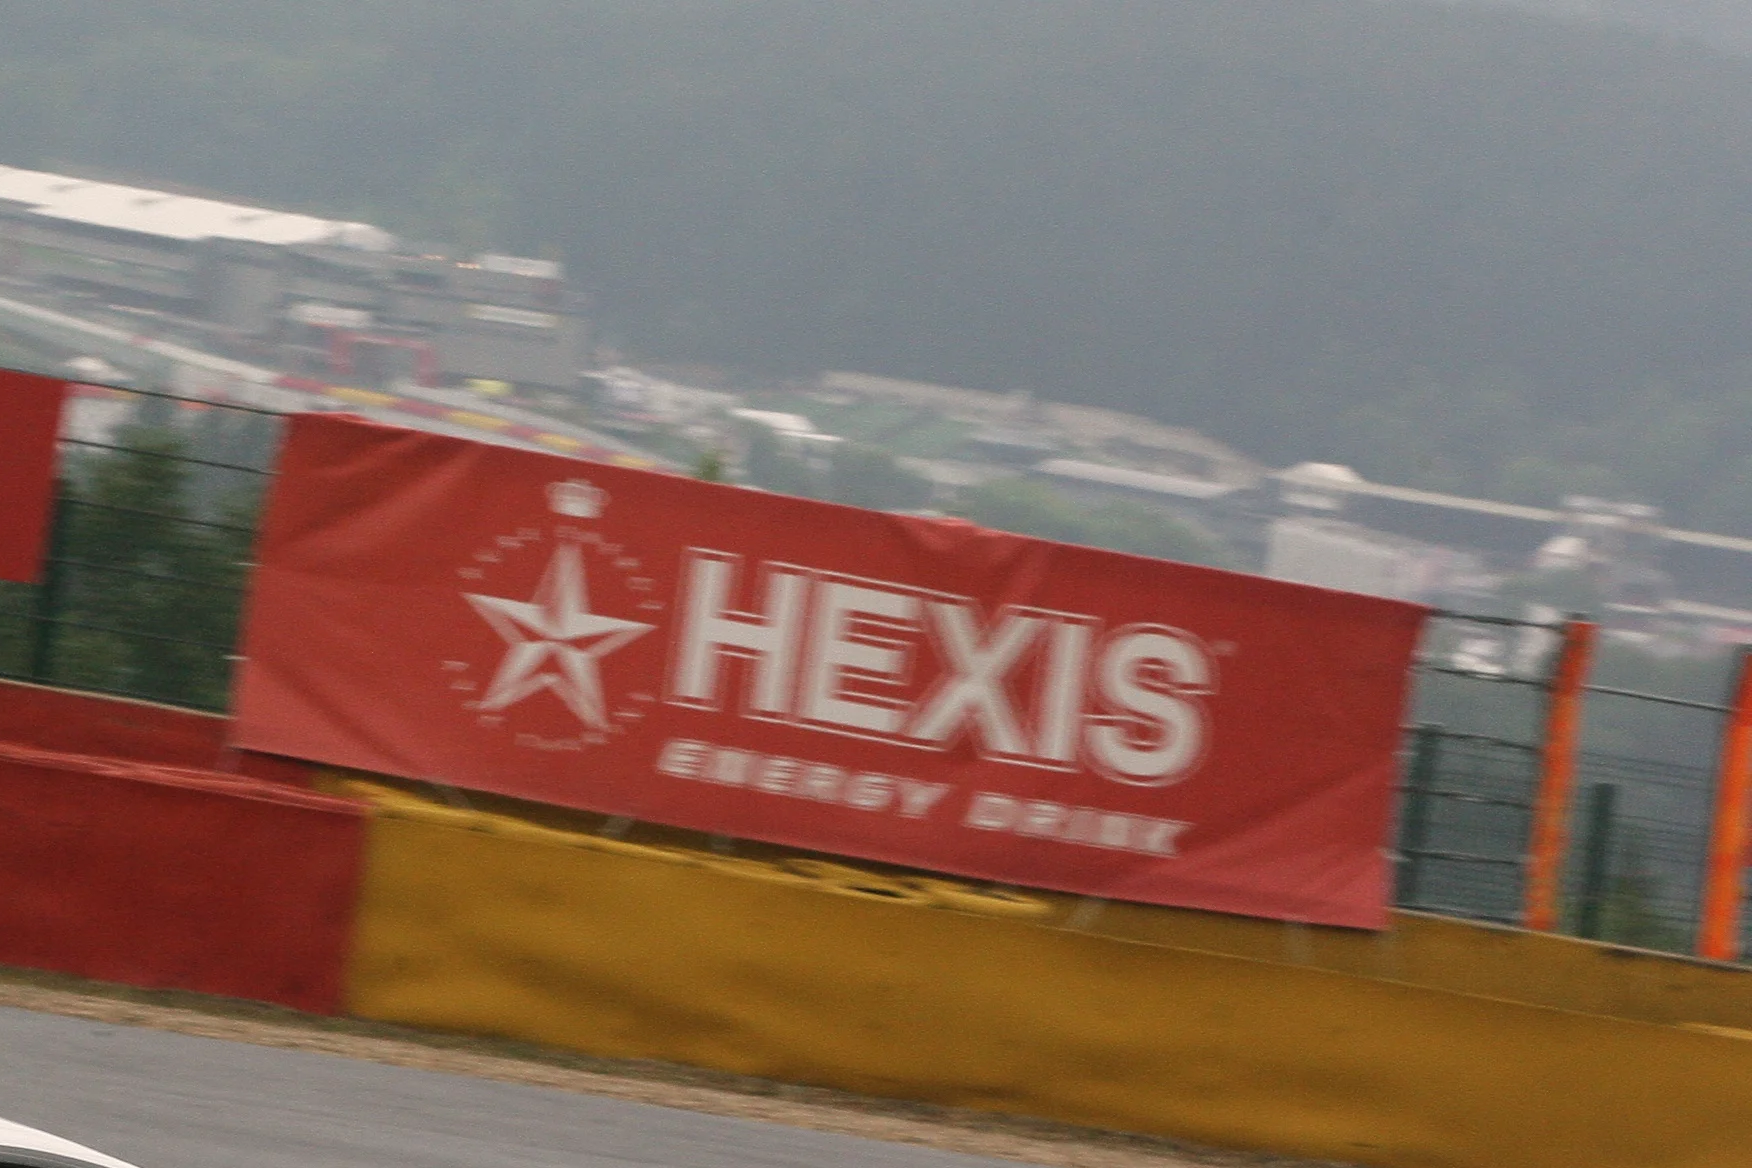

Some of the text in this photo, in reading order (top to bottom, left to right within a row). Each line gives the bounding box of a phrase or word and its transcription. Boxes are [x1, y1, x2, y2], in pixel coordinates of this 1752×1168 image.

[662, 545, 1218, 787] HEXIS
[657, 736, 1196, 858] ENERGY DRINK
